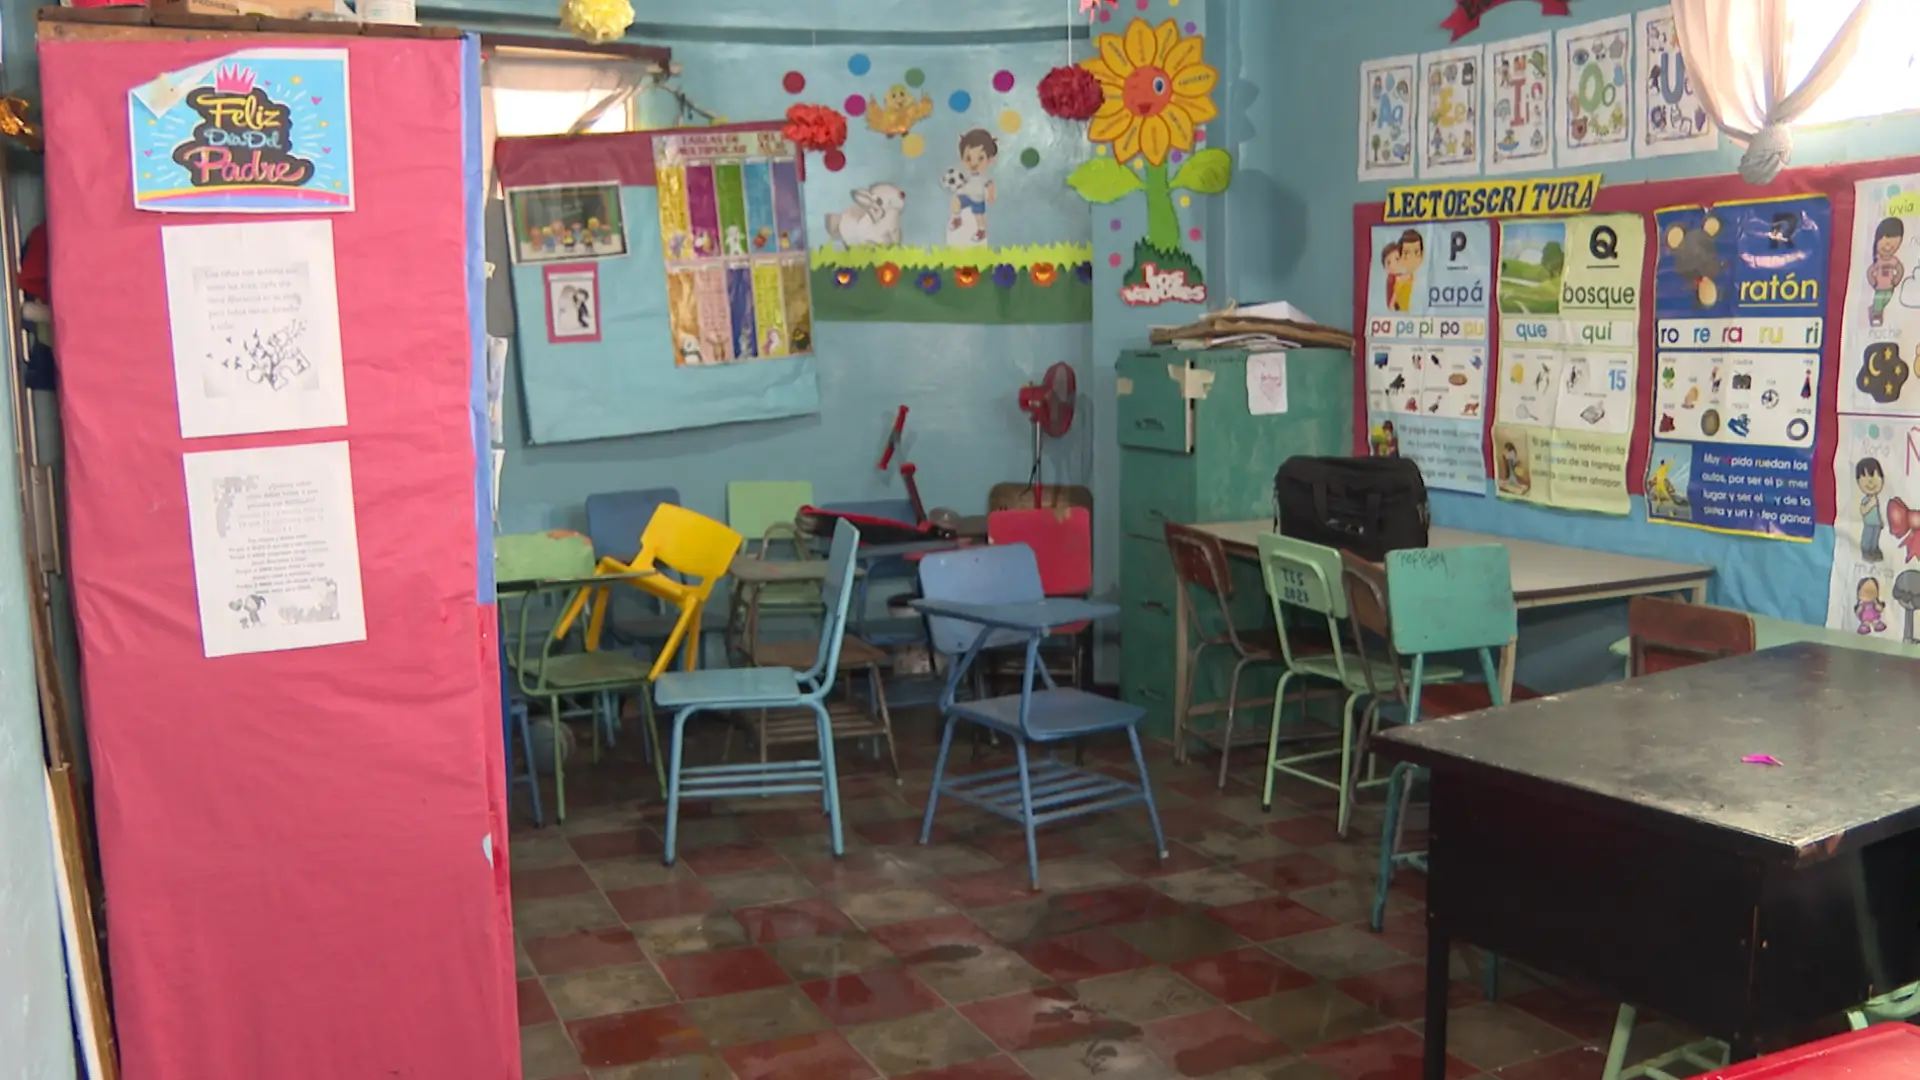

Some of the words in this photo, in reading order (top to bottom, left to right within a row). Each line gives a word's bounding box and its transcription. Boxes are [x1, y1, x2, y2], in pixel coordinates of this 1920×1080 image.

[1578, 61, 1616, 113] Oo
[196, 95, 281, 130] Feliz
[184, 146, 305, 183] Padre
[1386, 180, 1593, 218] LECTOESCRITURA
[1450, 231, 1467, 261] P
[1589, 225, 1618, 259] Q
[1428, 280, 1484, 307] papá
[1562, 282, 1635, 308] bosque
[1740, 272, 1818, 301] ratón
[1371, 320, 1391, 337] pa
[1396, 320, 1414, 337] pe
[1420, 317, 1434, 337] pi
[1440, 321, 1460, 337] po
[1516, 323, 1547, 341] que
[1661, 326, 1680, 344] ro
[1693, 326, 1711, 344] re
[1722, 326, 1743, 344] ra
[1759, 326, 1784, 344] ru
[1806, 322, 1819, 344] ri
[1608, 369, 1627, 391] 15
[1755, 457, 1791, 469] ruedan
[1793, 459, 1809, 471] los
[1728, 475, 1745, 486] por
